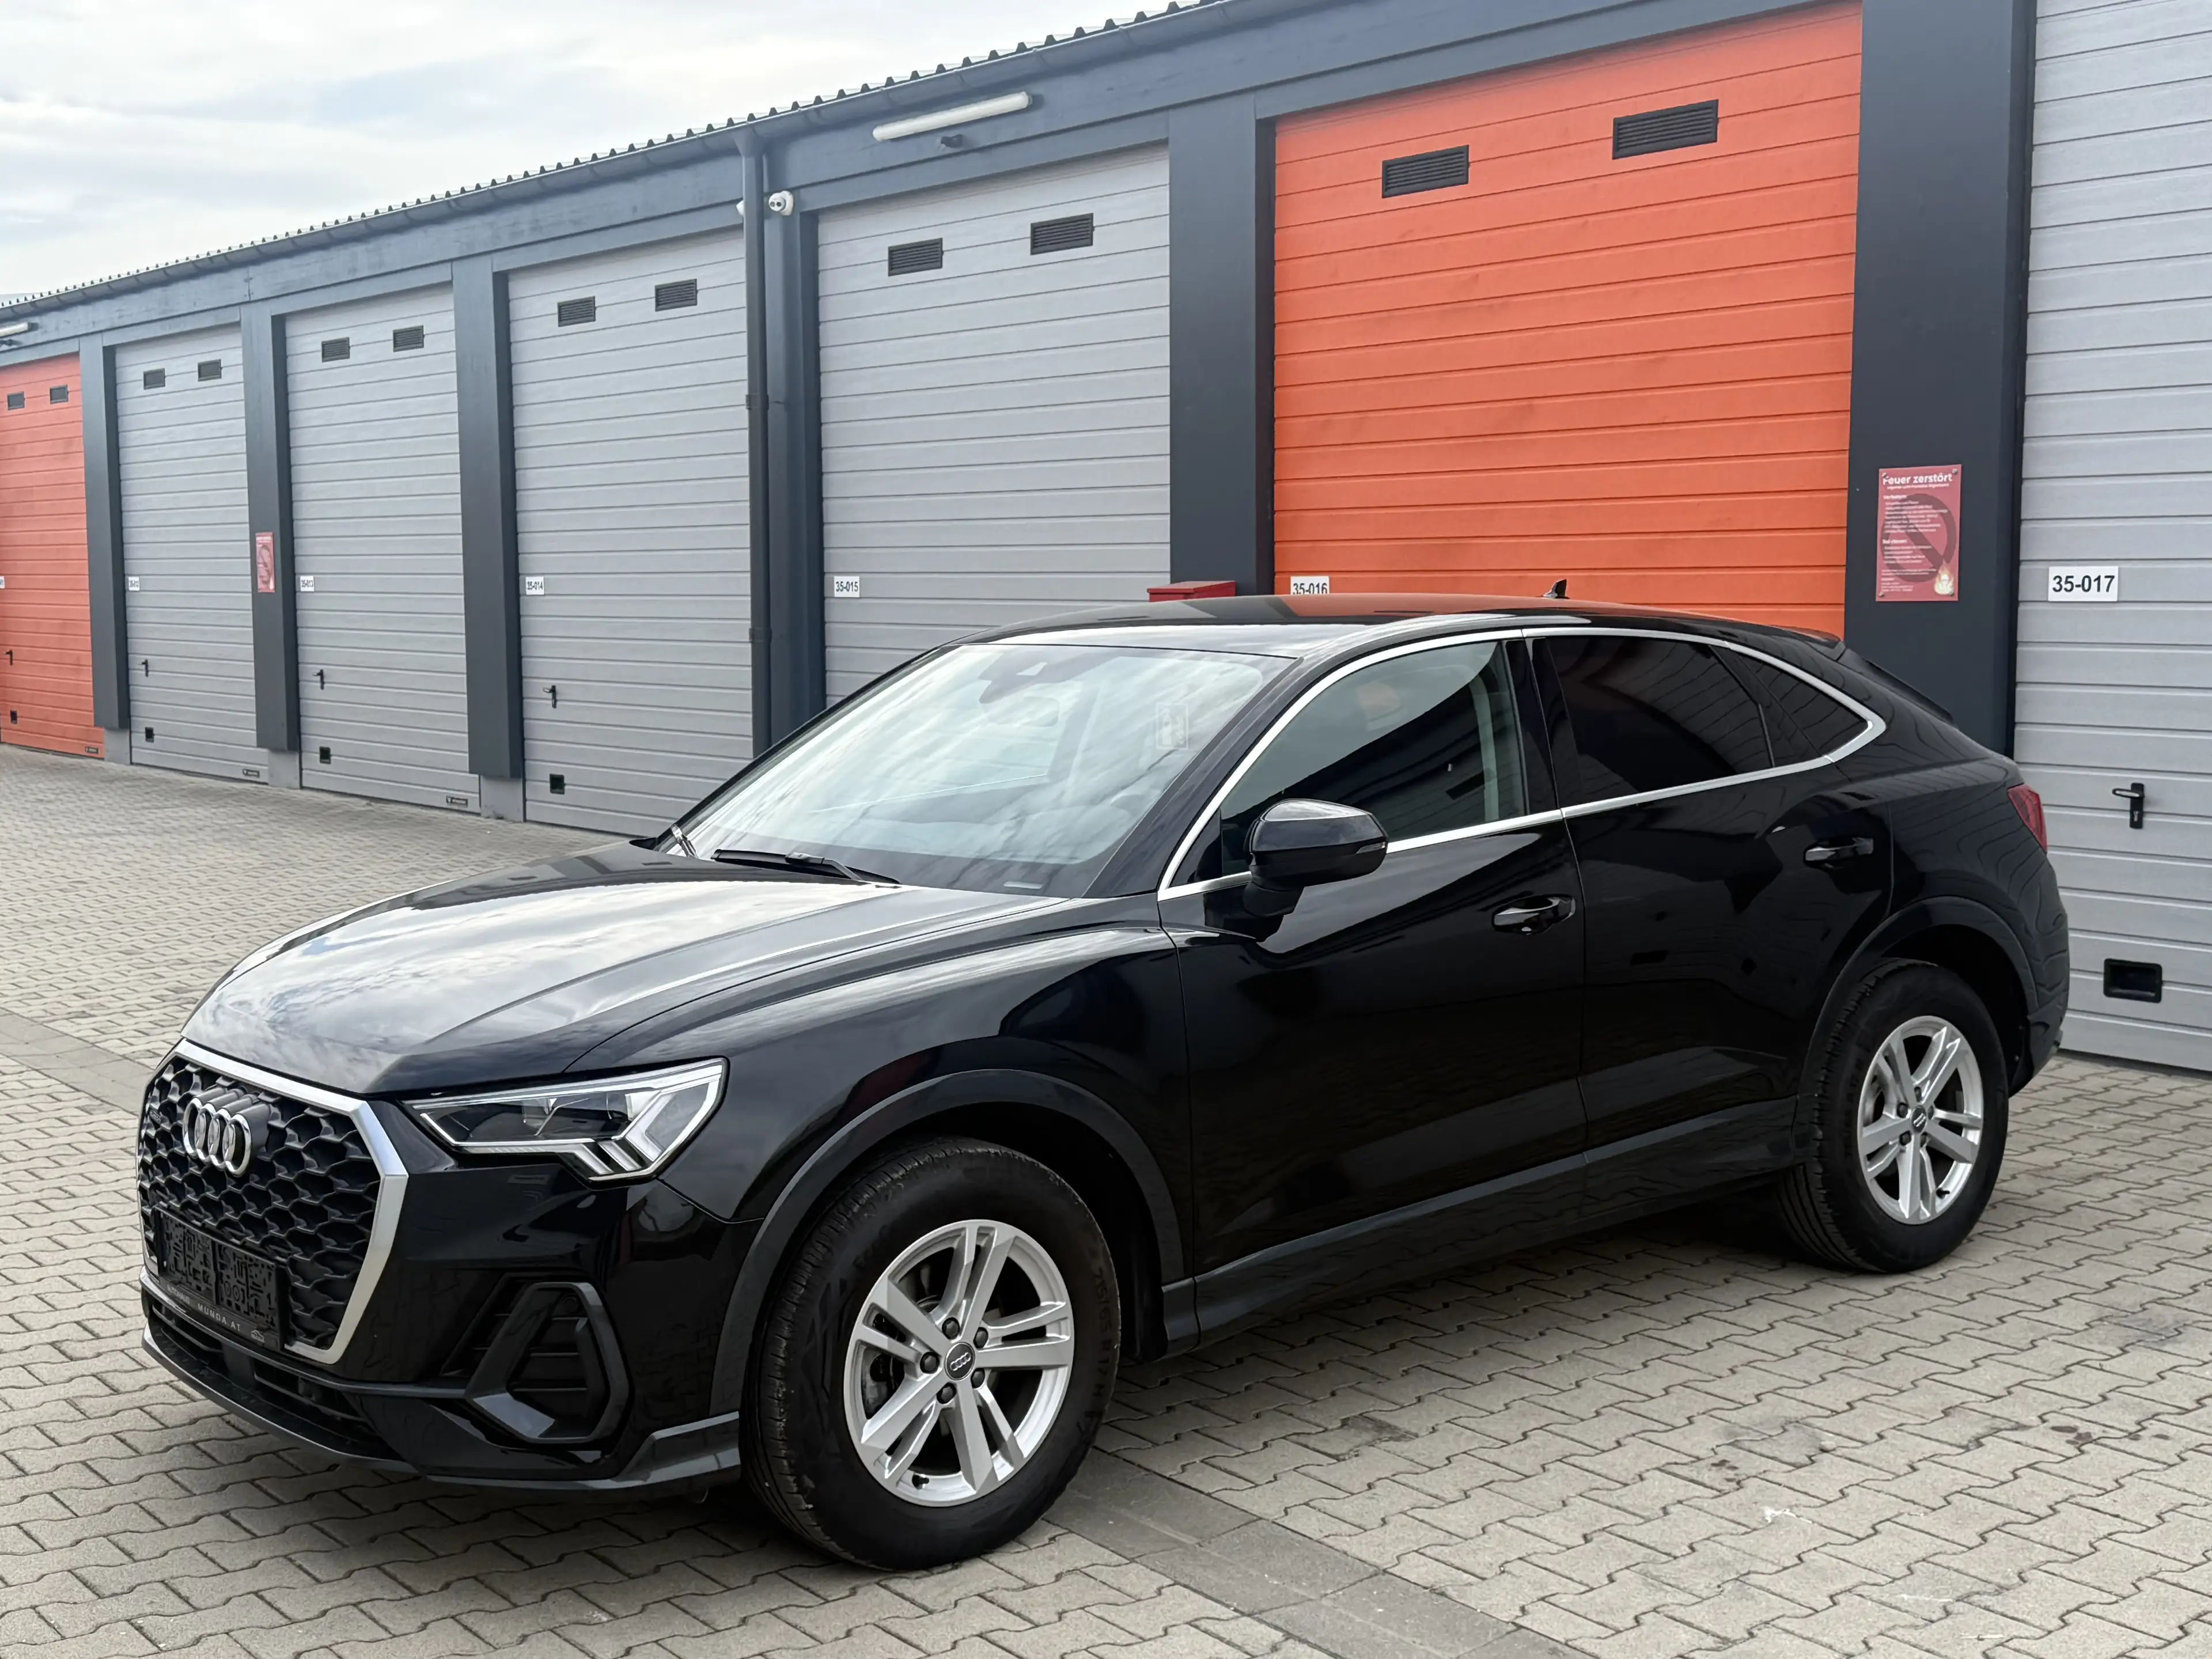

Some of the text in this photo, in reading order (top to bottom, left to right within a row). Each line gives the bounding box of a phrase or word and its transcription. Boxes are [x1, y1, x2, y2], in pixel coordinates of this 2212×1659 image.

[1913, 472, 1952, 484] zerstört
[527, 581, 543, 590] 35-014
[835, 581, 858, 592] 35-015
[1293, 582, 1328, 594] 35-016
[2052, 575, 2115, 592] 35-017
